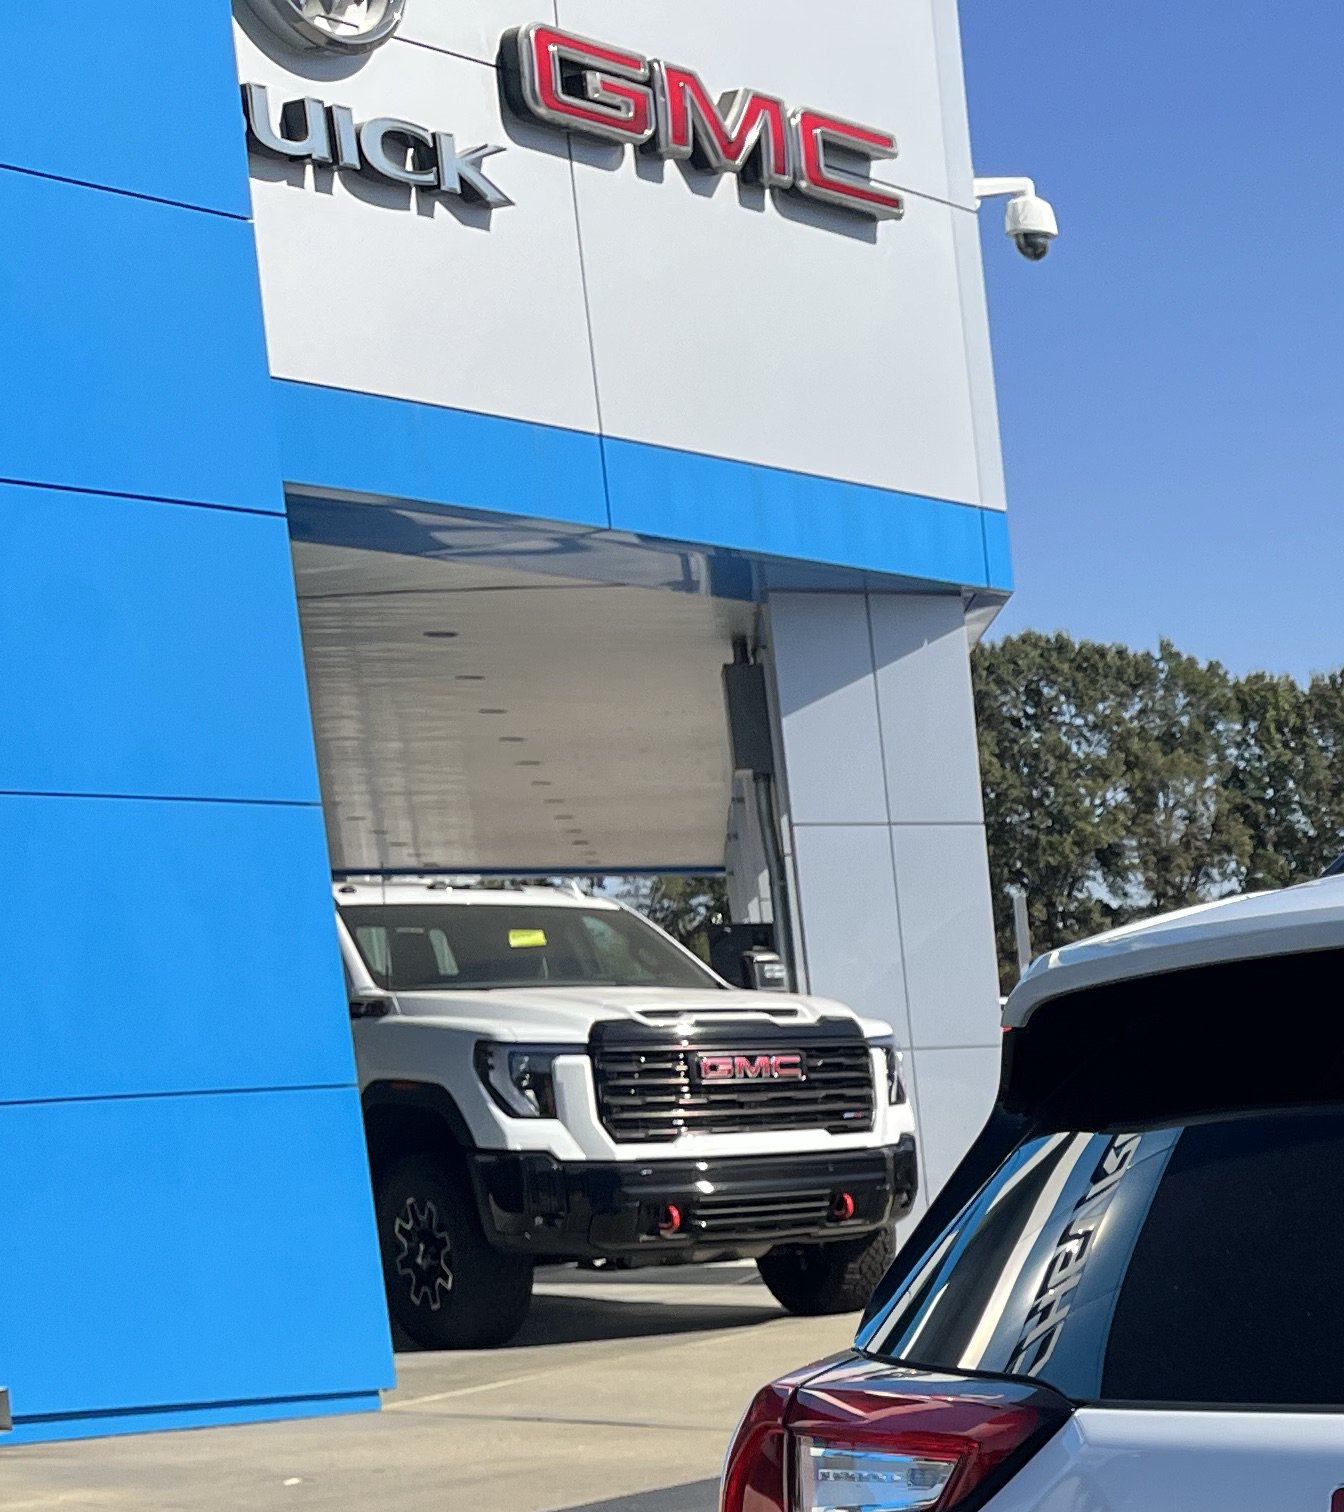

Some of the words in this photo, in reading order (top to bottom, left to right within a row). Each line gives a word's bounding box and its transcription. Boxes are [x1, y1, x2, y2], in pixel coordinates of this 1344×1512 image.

[240, 82, 515, 209] UICK
[498, 22, 904, 221] GMC
[701, 1054, 801, 1080] GMC
